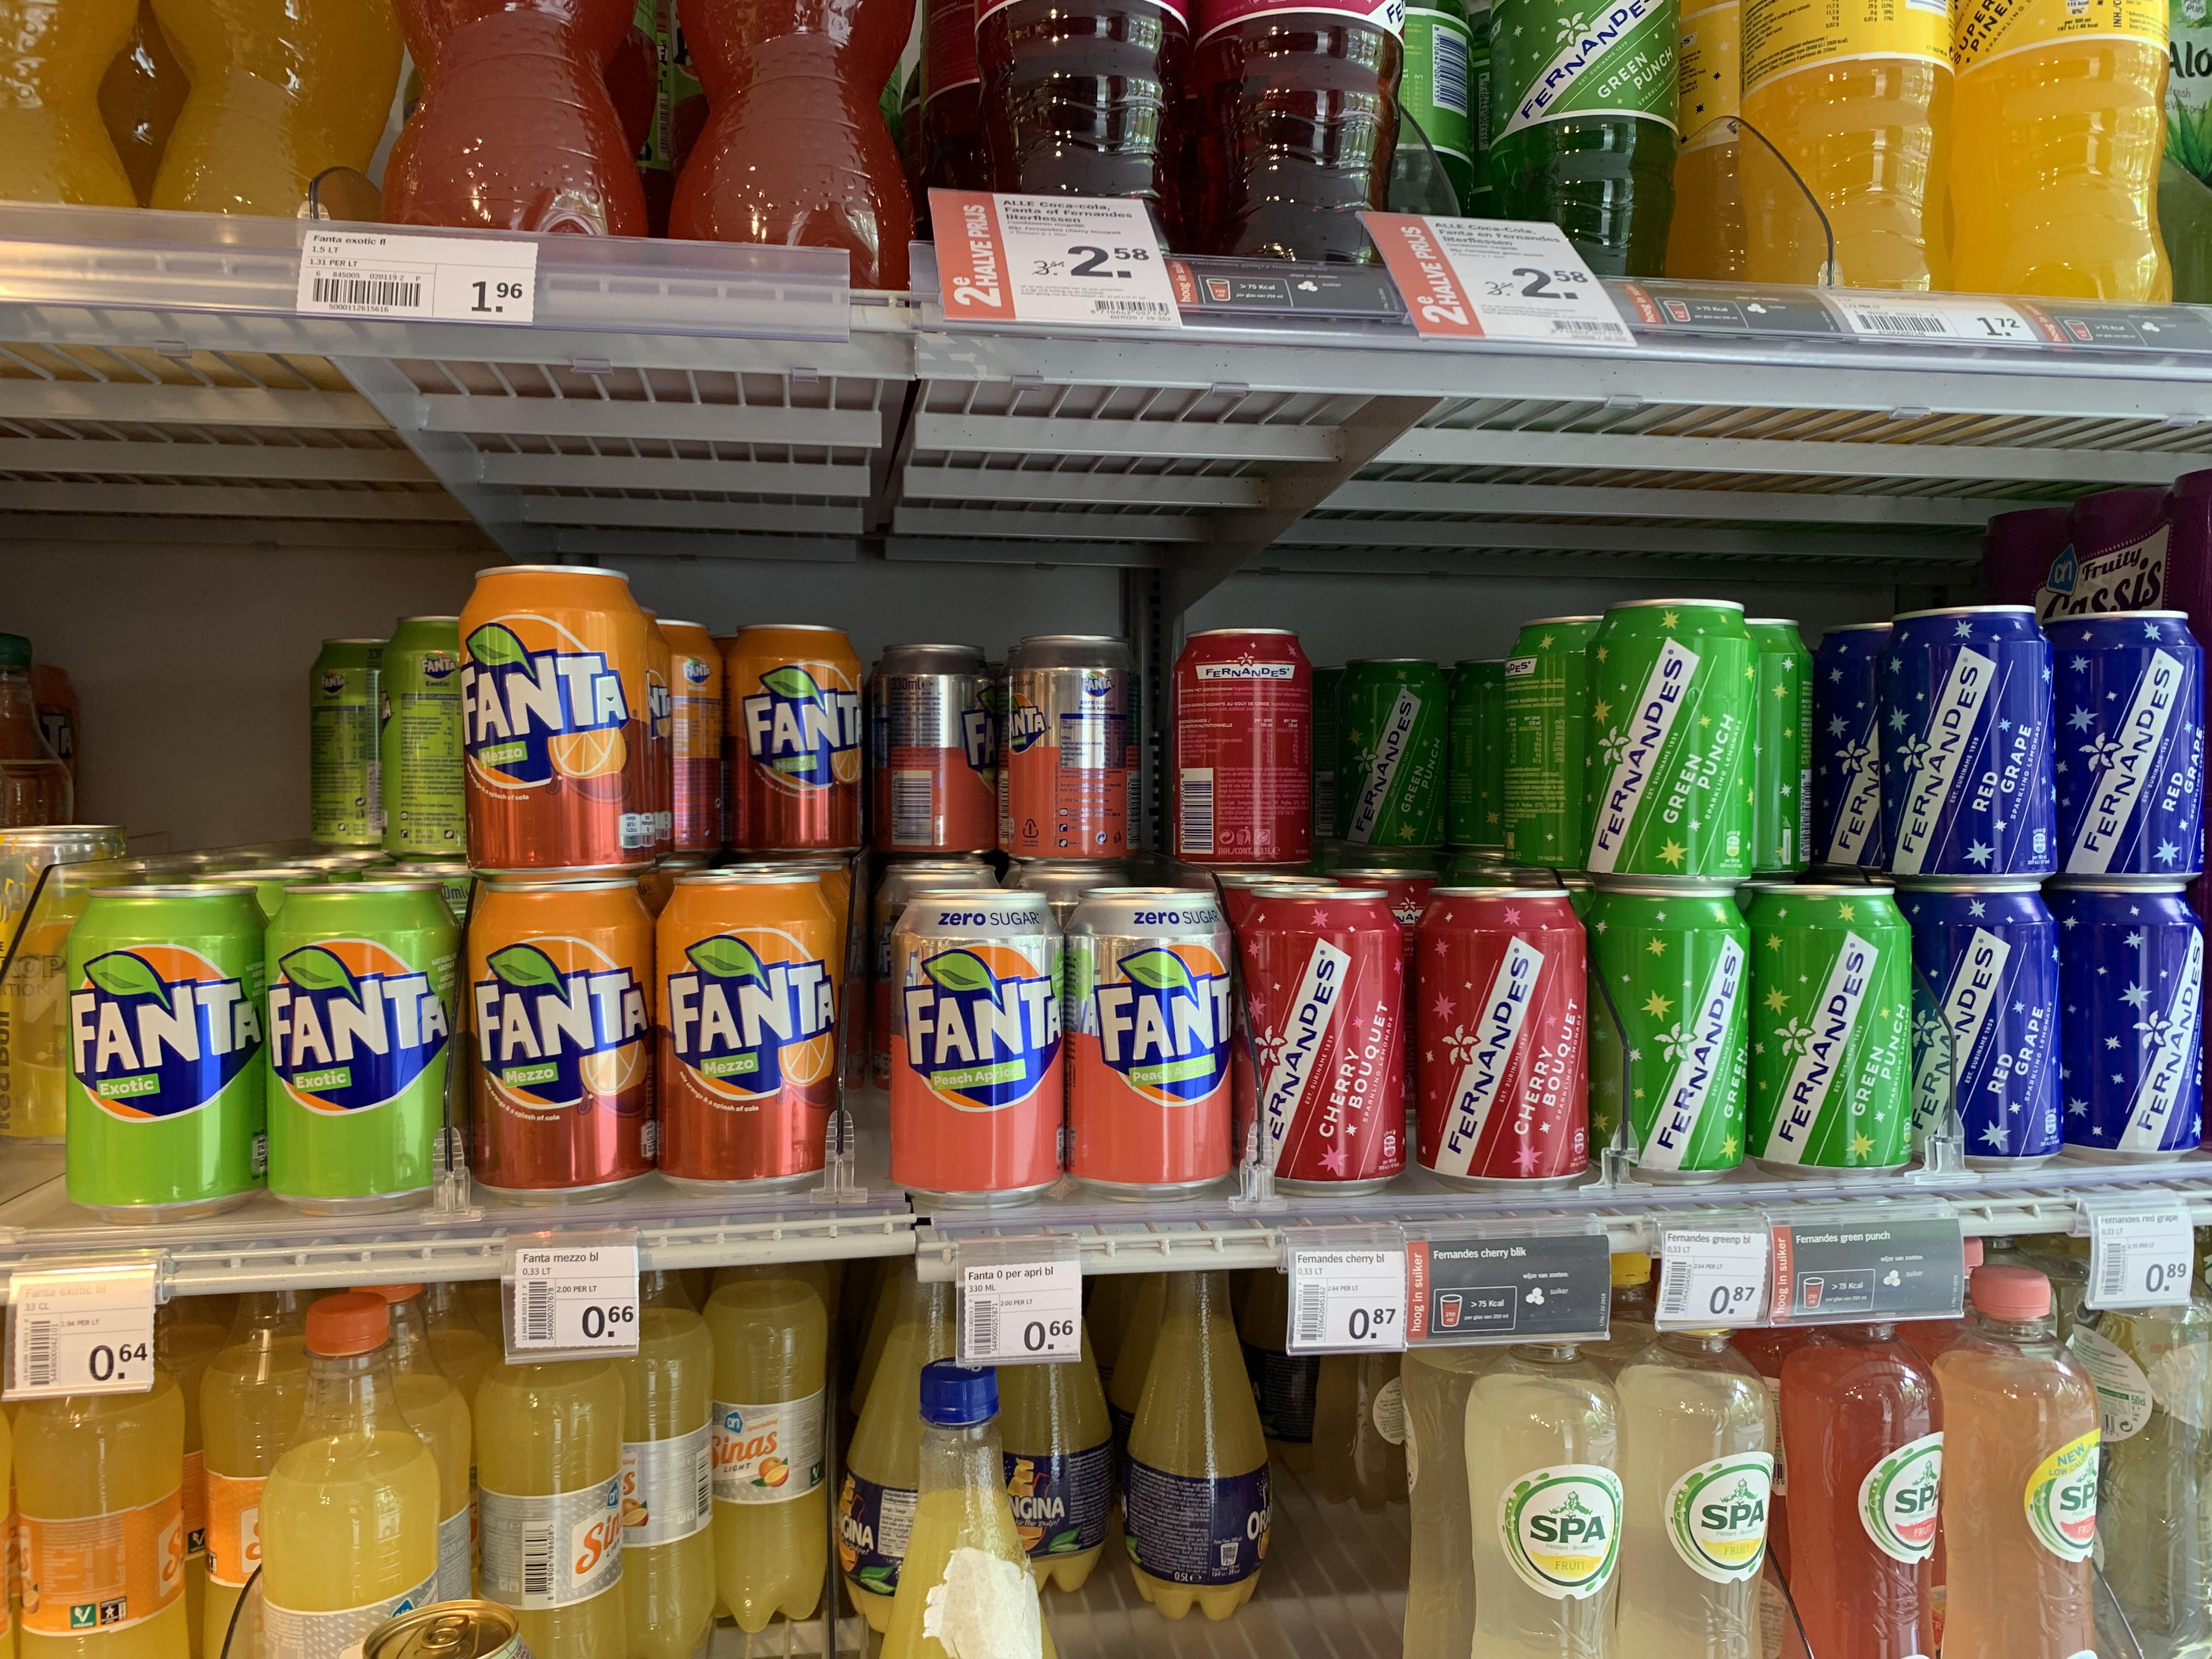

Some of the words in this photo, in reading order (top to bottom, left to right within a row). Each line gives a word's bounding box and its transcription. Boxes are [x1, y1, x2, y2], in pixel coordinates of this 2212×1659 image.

[2186, 3, 2204, 14] PLUS
[1954, 0, 1996, 64] SUPER
[1985, 5, 2025, 53] SPARKLING
[1598, 52, 1647, 98] GREEN
[1633, 47, 1673, 90] PUNCH
[963, 204, 990, 239] PRIJS
[1006, 214, 1081, 223] literflessen
[1063, 210, 1132, 218] Fernandes
[313, 235, 342, 244] Fanta
[1401, 226, 1437, 259] PRIJS
[970, 241, 995, 286] HALVE
[1068, 246, 1149, 278] 2.58
[471, 281, 522, 312] 1.96
[1420, 258, 1454, 306] HALVE
[1513, 268, 1588, 300] 2.58
[1977, 318, 2020, 336] 1.72
[2082, 548, 2142, 582] Fruity
[420, 657, 456, 675] FANTA
[1206, 668, 1287, 678] FERNANDES
[461, 655, 627, 746] FANTA
[1081, 677, 1112, 690] FANTA
[479, 745, 523, 766] Mezzo
[776, 758, 814, 771] Mezzo
[1355, 699, 1412, 833] FERNANDES
[1423, 738, 1441, 789] PUNCH
[1598, 658, 1683, 851] FERNANDES
[1697, 713, 1734, 790] PUNCH
[1901, 665, 1979, 855] FERNANDES
[2000, 724, 2033, 794] GRAPE
[2083, 667, 2171, 853] FERNANDES
[2183, 726, 2204, 795] GRAPE
[1705, 771, 1726, 820] SPARKLING
[1724, 719, 1742, 771] LEMONADE
[2010, 768, 2030, 820] SPARKLING
[2026, 720, 2042, 769] LEMONADE
[1401, 765, 1425, 813] GREEN
[1662, 753, 1703, 824] GREEN
[1972, 770, 1999, 814] RED
[2162, 770, 2183, 812] RED
[1217, 847, 1254, 856] INH./CONT.
[938, 911, 986, 926] zero
[1133, 910, 1180, 924] zero
[1183, 910, 1220, 924] SUGAR
[268, 979, 448, 1069] FANTA
[475, 972, 647, 1062] FANTA
[670, 966, 834, 1054] FANTA
[905, 979, 1062, 1064] FANTA
[70, 983, 262, 1076] FANTA
[1881, 1004, 1906, 1081] PUNCH
[2015, 1006, 2044, 1075] GRAPE
[2137, 944, 2202, 1131] FERNANDES
[1269, 957, 1335, 1141] ERNANDES
[1348, 1000, 1388, 1109] BOUQUET
[1447, 956, 1528, 1154] FERNANDES
[1541, 998, 1578, 1107] BOUQUET
[1657, 953, 1736, 1150] FERNANDES
[1778, 951, 1865, 1143] FERNANDES
[2024, 1050, 2042, 1102] SPARKLING
[2039, 1001, 2053, 1048] LEMONADE
[296, 1071, 347, 1091] Exotic
[505, 1066, 555, 1084] Mezzo
[704, 1058, 754, 1075] Mezzo
[933, 1071, 973, 1086] Peach
[975, 1066, 1024, 1084] Apricot
[1132, 1068, 1171, 1083] Peach
[1173, 1063, 1215, 1078] Apricot
[1362, 1070, 1382, 1123] SPARKLING
[1379, 1015, 1394, 1070] LEMONADE
[1555, 1069, 1573, 1122] SPARKLING
[1568, 1013, 1582, 1067] LEMONADE
[1723, 1047, 1745, 1118] GREEN
[1851, 1045, 1884, 1117] GREEN
[1987, 1052, 2013, 1094] RED
[99, 1077, 154, 1097] Exotic
[1318, 1047, 1361, 1138] CHERRY
[1513, 1045, 1553, 1136] CHERRY
[2157, 1214, 2179, 1223] grape
[1434, 1249, 1479, 1260] Fernandes
[1481, 1248, 1509, 1259] cherry
[1510, 1247, 1526, 1257] blik
[1667, 1233, 1709, 1243] Fernandes
[1712, 1235, 1741, 1245] greenp
[1796, 1234, 1838, 1244] Fernandes
[1841, 1233, 1864, 1243] green
[1865, 1231, 1891, 1242] punch
[523, 1254, 550, 1262] Fanta
[590, 1252, 599, 1261] bl
[1346, 1254, 1374, 1265] cherry
[1376, 1254, 1384, 1262] bl
[1413, 1252, 1423, 1288] suiker
[1777, 1238, 1787, 1272] suiker
[969, 1272, 994, 1280] Fanta
[1006, 1270, 1021, 1280] per
[1024, 1267, 1042, 1278] apri
[1045, 1267, 1053, 1275] bl
[1778, 1275, 1787, 1285] in
[2146, 1263, 2186, 1292] 0.89
[38, 1302, 50, 1311] CL
[1413, 1291, 1423, 1302] in
[1709, 1286, 1755, 1314] 0.87
[1775, 1288, 1788, 1313] hoog
[582, 1306, 634, 1338] 0.66
[1349, 1308, 1396, 1339] 0.87
[1410, 1305, 1424, 1331] hoog
[1024, 1320, 1073, 1351] 0.66
[89, 1343, 148, 1381] 0.64
[713, 1430, 778, 1470] Sinas
[2056, 1443, 2085, 1466] NEW
[723, 1462, 751, 1474] LIGHT
[2048, 1468, 2068, 1477] LOW
[1008, 1496, 1065, 1519] NGINA
[1701, 1499, 1764, 1530] SPA
[1530, 1516, 1606, 1543] SPA
[1555, 1560, 1587, 1571] FRUIT
[1723, 1544, 1751, 1557] FRUIT
